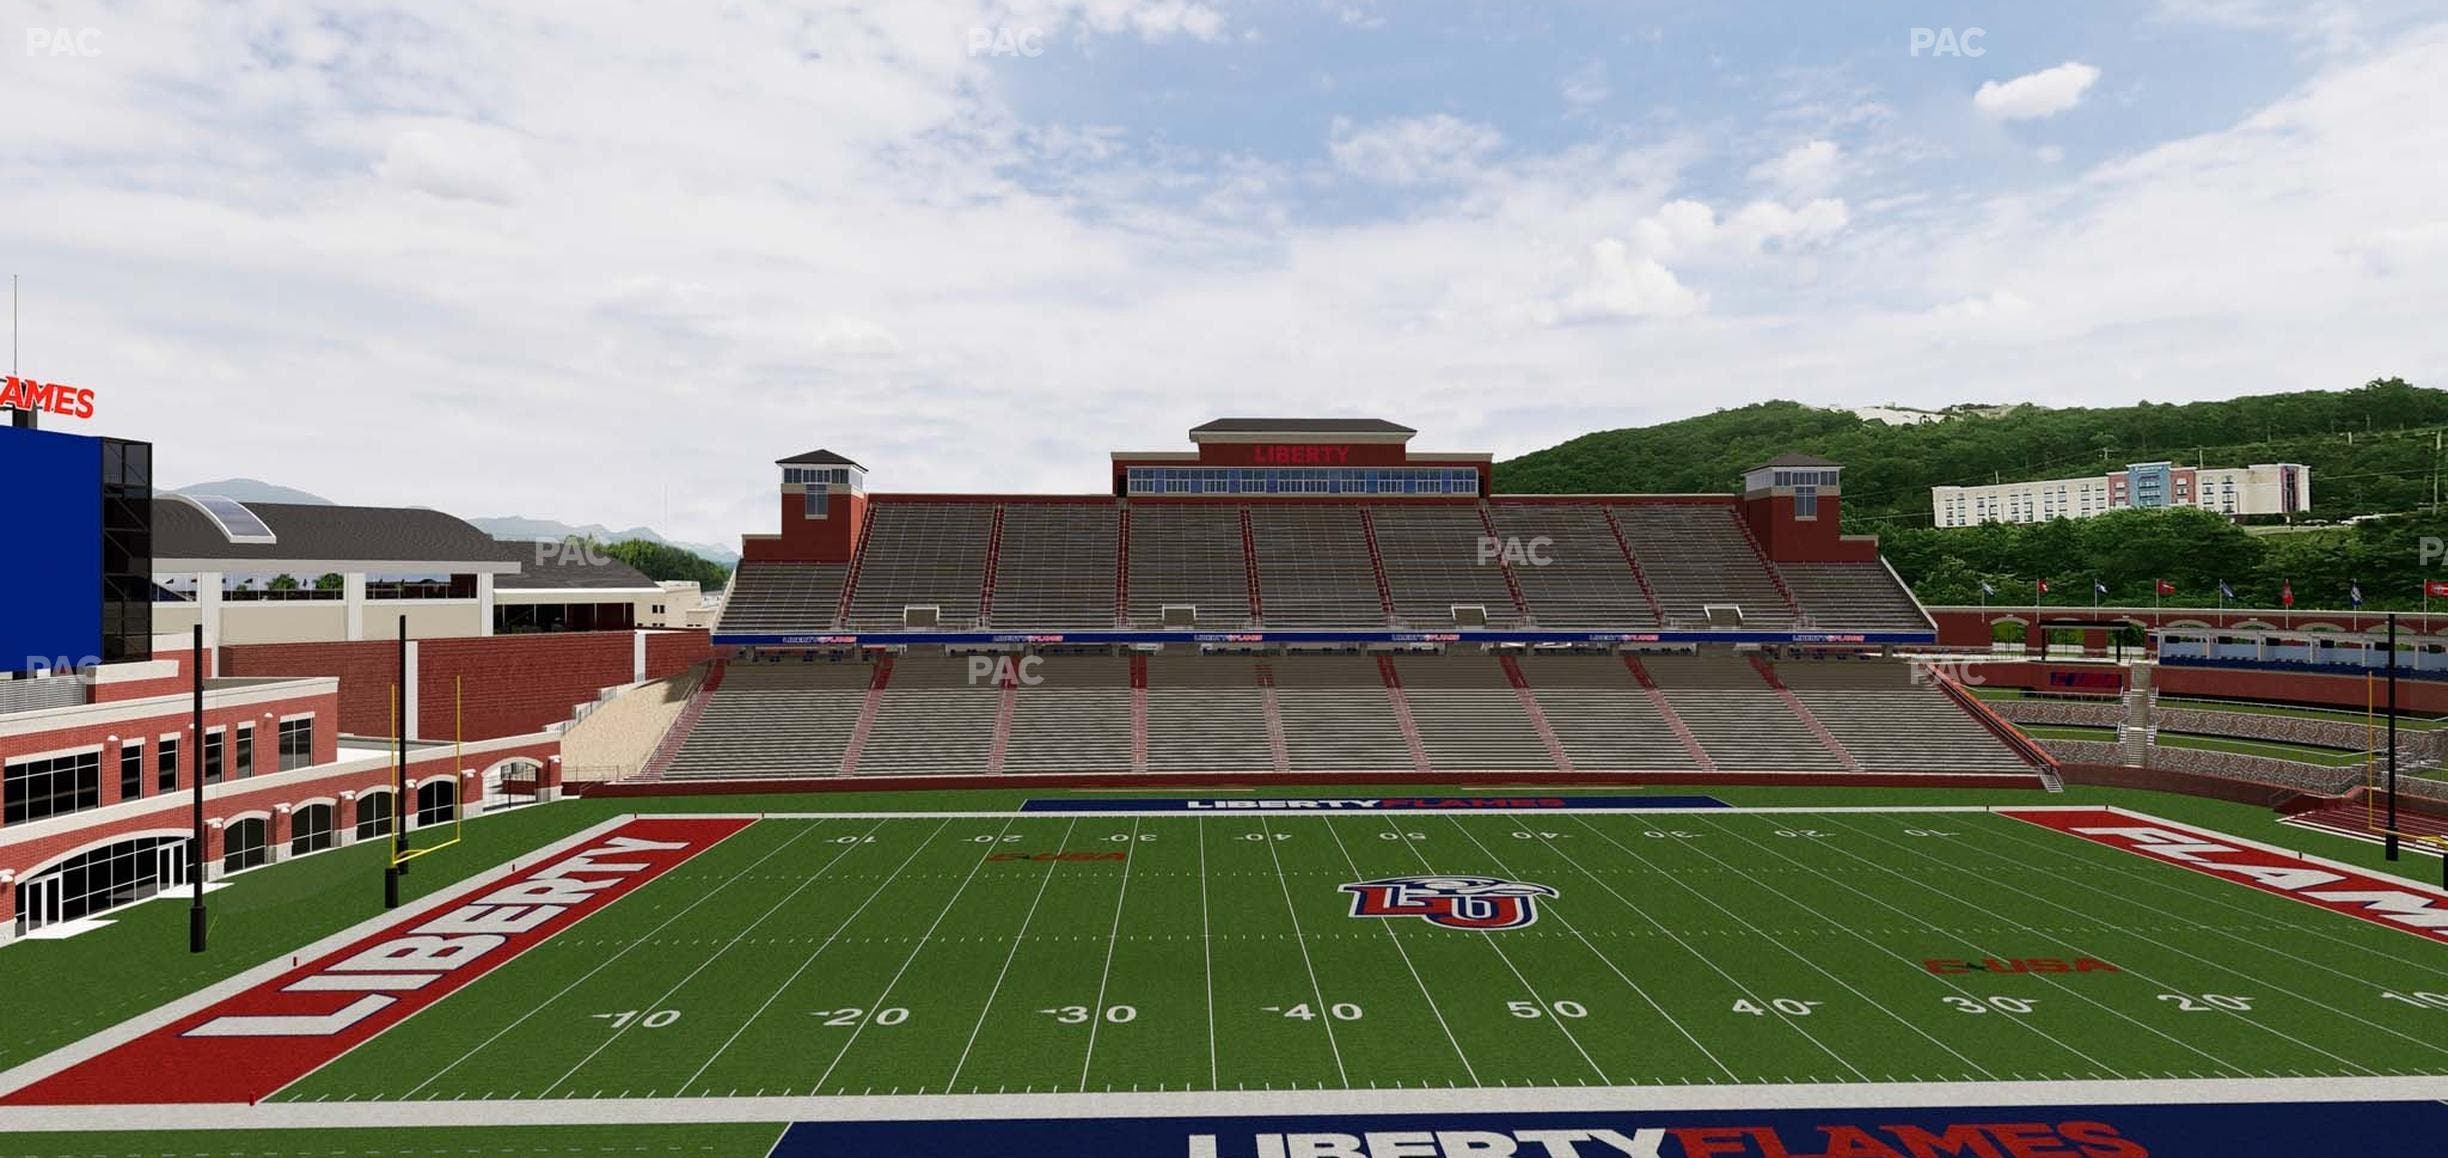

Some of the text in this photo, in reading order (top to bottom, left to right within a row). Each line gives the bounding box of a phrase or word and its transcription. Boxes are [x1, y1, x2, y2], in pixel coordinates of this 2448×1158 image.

[0, 375, 96, 420] AMES
[1254, 446, 1348, 464] LIBERTY
[178, 836, 692, 1037] LIBERTY
[1283, 1002, 1364, 1021] 40
[1506, 1000, 1589, 1019] 50
[1732, 998, 1812, 1016] 40
[1942, 996, 2033, 1013] 30
[2157, 994, 2252, 1011] 20
[610, 1009, 682, 1028] 10
[823, 1007, 910, 1026] 20
[1056, 1005, 1138, 1024] 30
